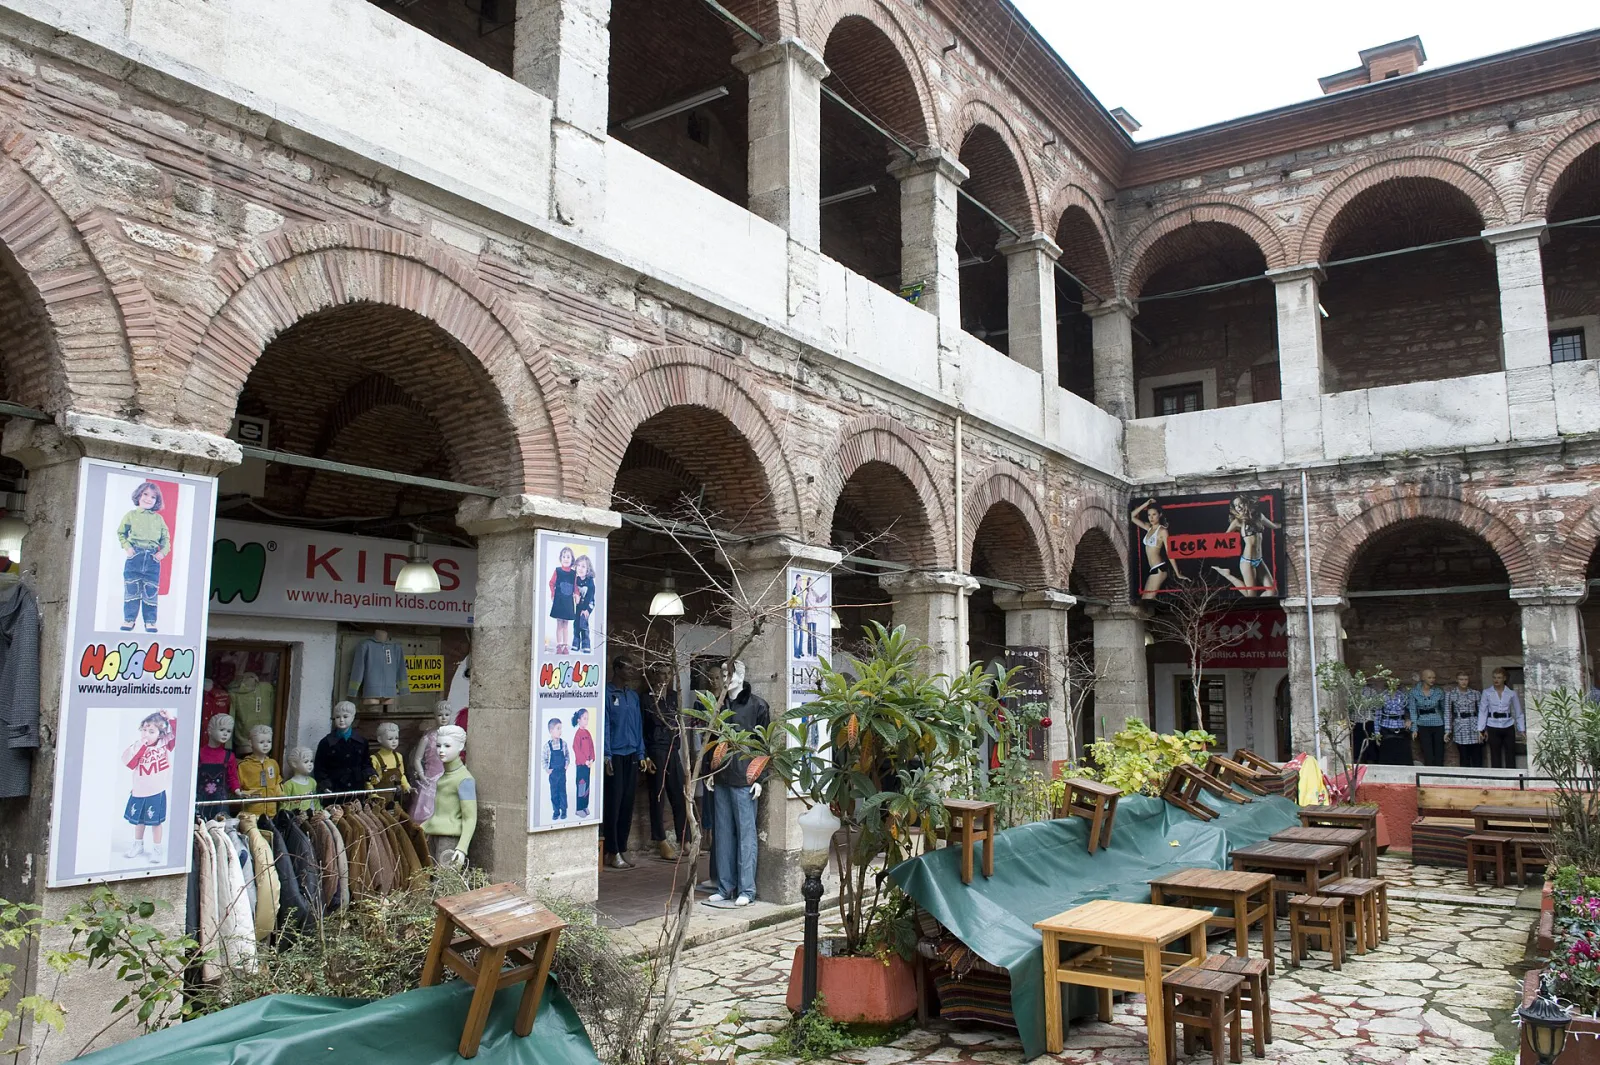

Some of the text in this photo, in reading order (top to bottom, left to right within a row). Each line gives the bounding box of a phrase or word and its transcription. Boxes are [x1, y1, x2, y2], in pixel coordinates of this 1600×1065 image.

[1170, 537, 1237, 554] LOOK ME
[1240, 650, 1266, 660] SATIŞ
[424, 658, 442, 670] KIDS
[78, 683, 192, 696] www.hayalimkids.com.tr
[539, 690, 599, 700] www.hayalimkids.com.tr
[139, 757, 170, 776] ME
